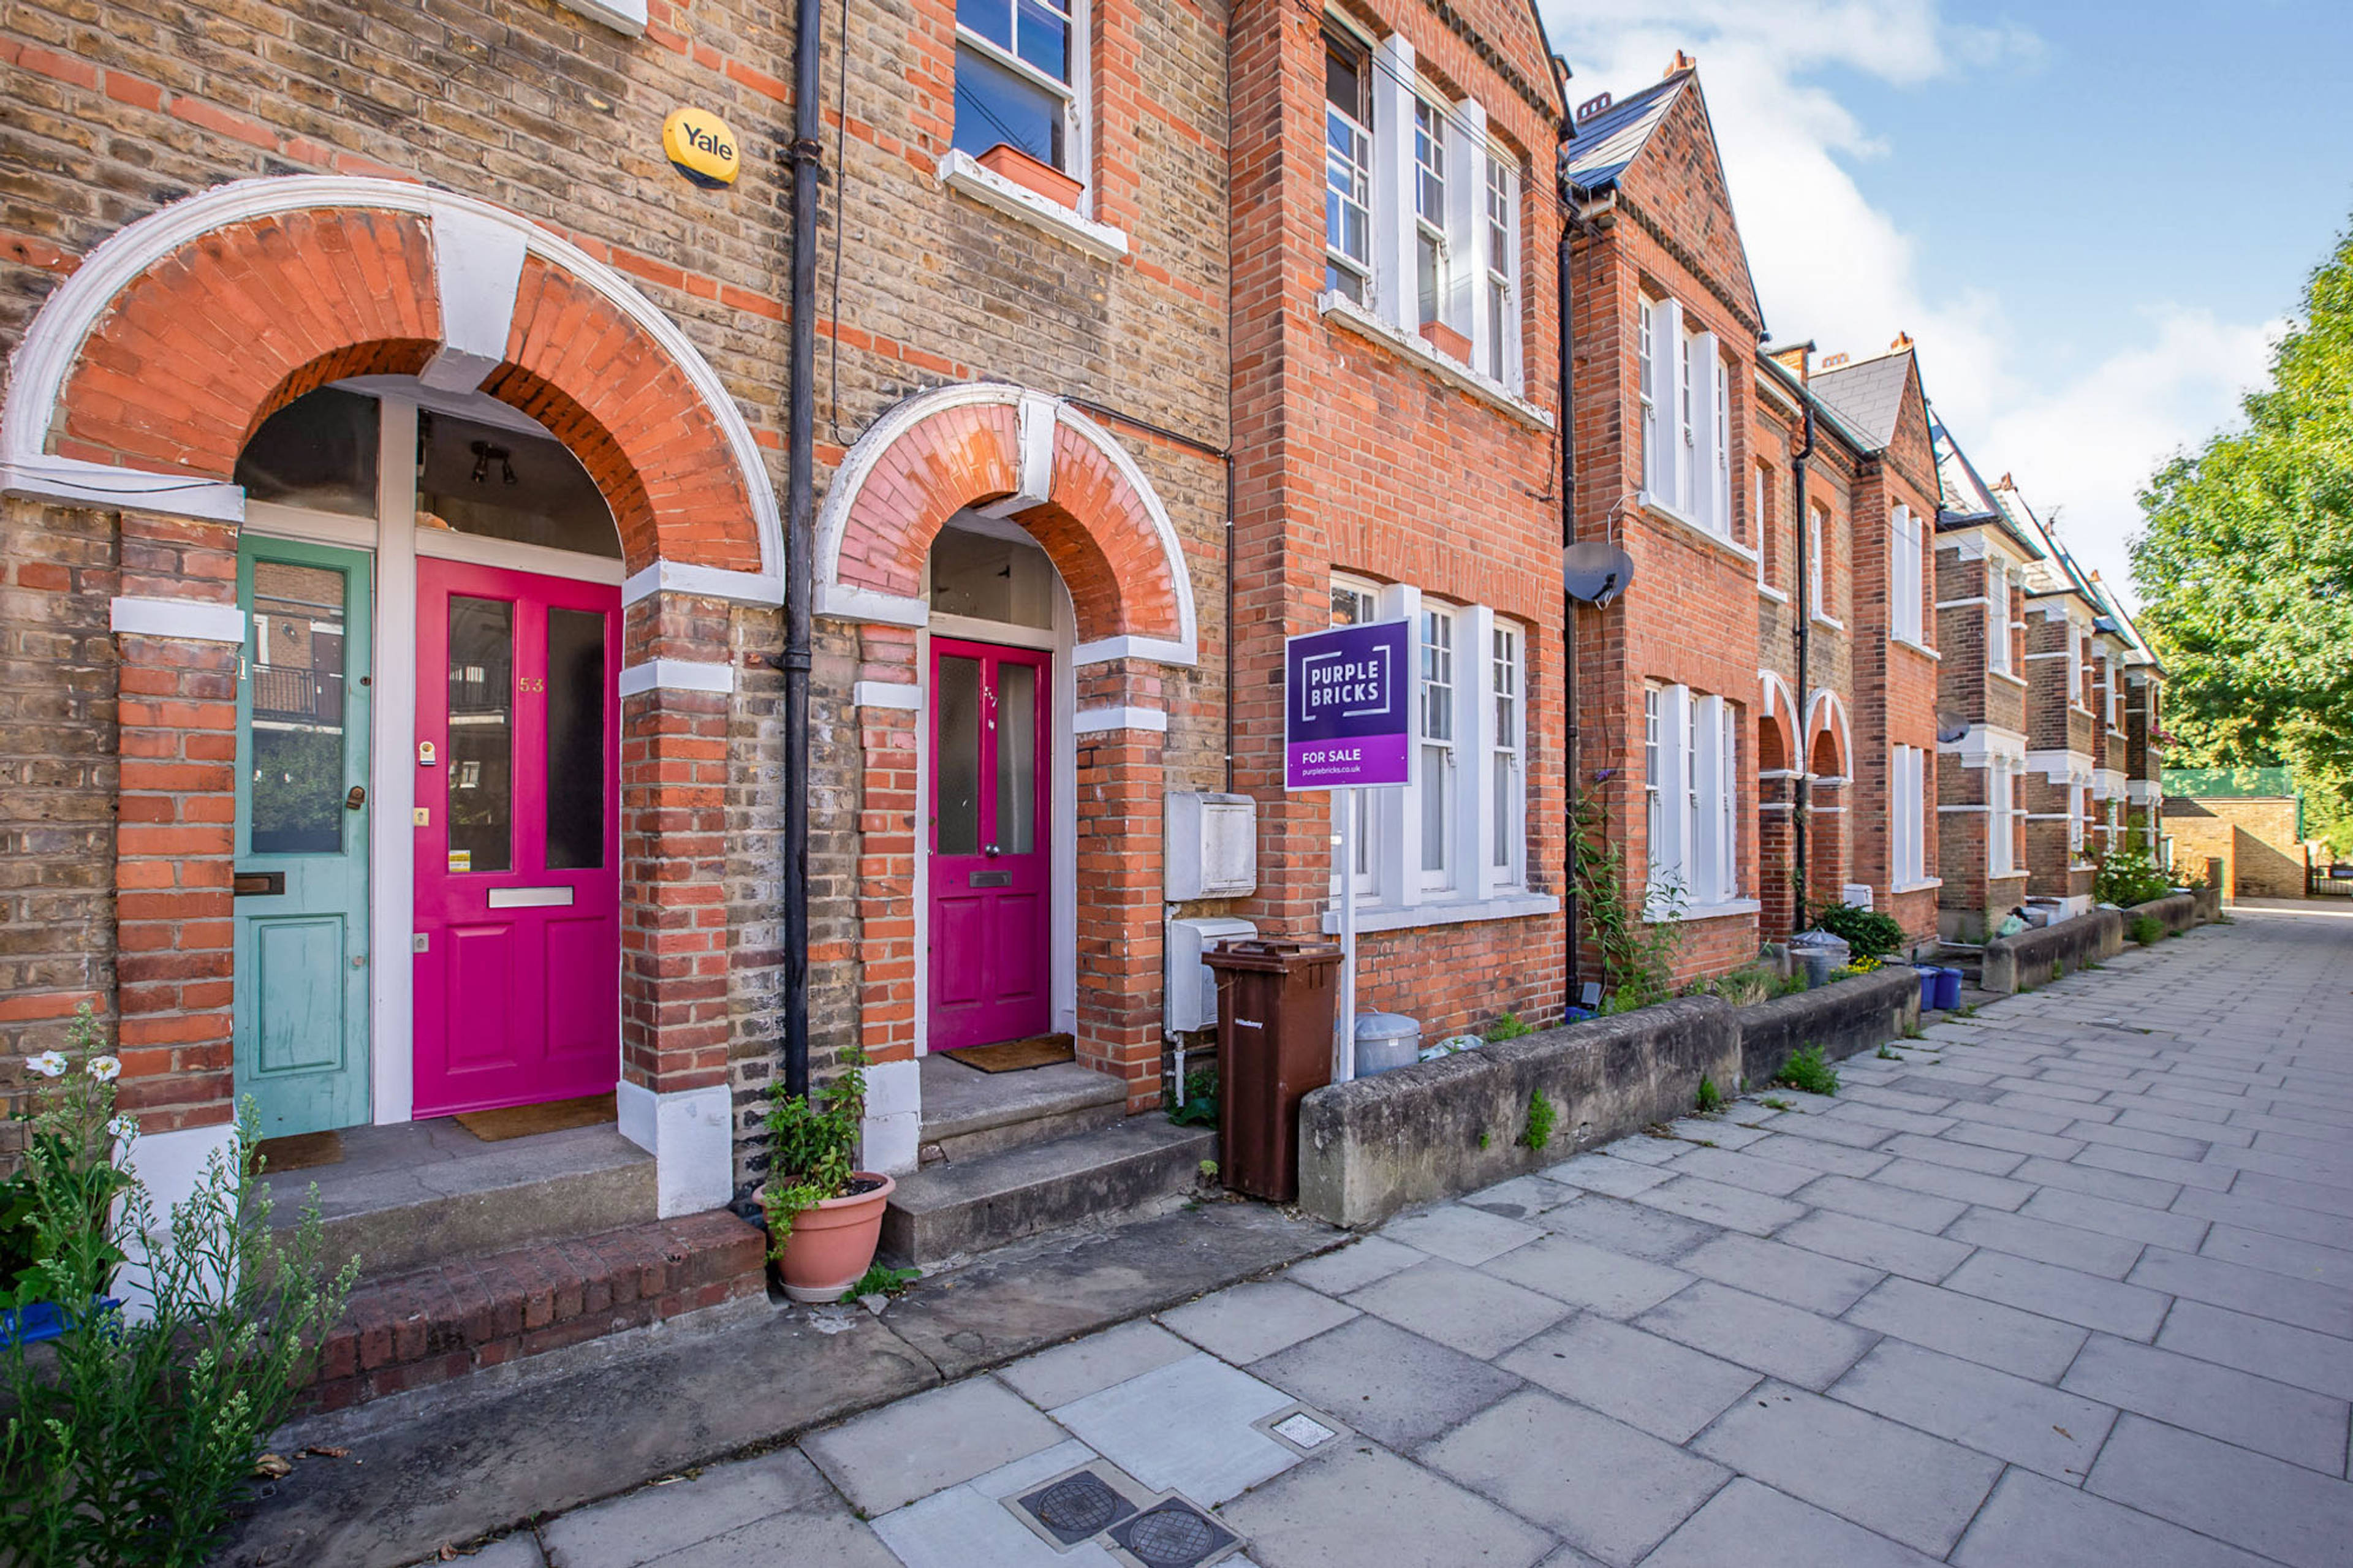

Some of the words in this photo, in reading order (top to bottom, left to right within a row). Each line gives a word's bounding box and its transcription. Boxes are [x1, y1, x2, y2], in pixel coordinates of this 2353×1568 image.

[683, 122, 733, 161] Yale
[1311, 660, 1379, 686] PURPLE
[520, 677, 544, 693] 53
[1311, 682, 1379, 707] BRICKS
[1302, 752, 1325, 764] FOR
[1328, 748, 1362, 762] SALE
[1302, 765, 1361, 777] purplebricks.co.uk
